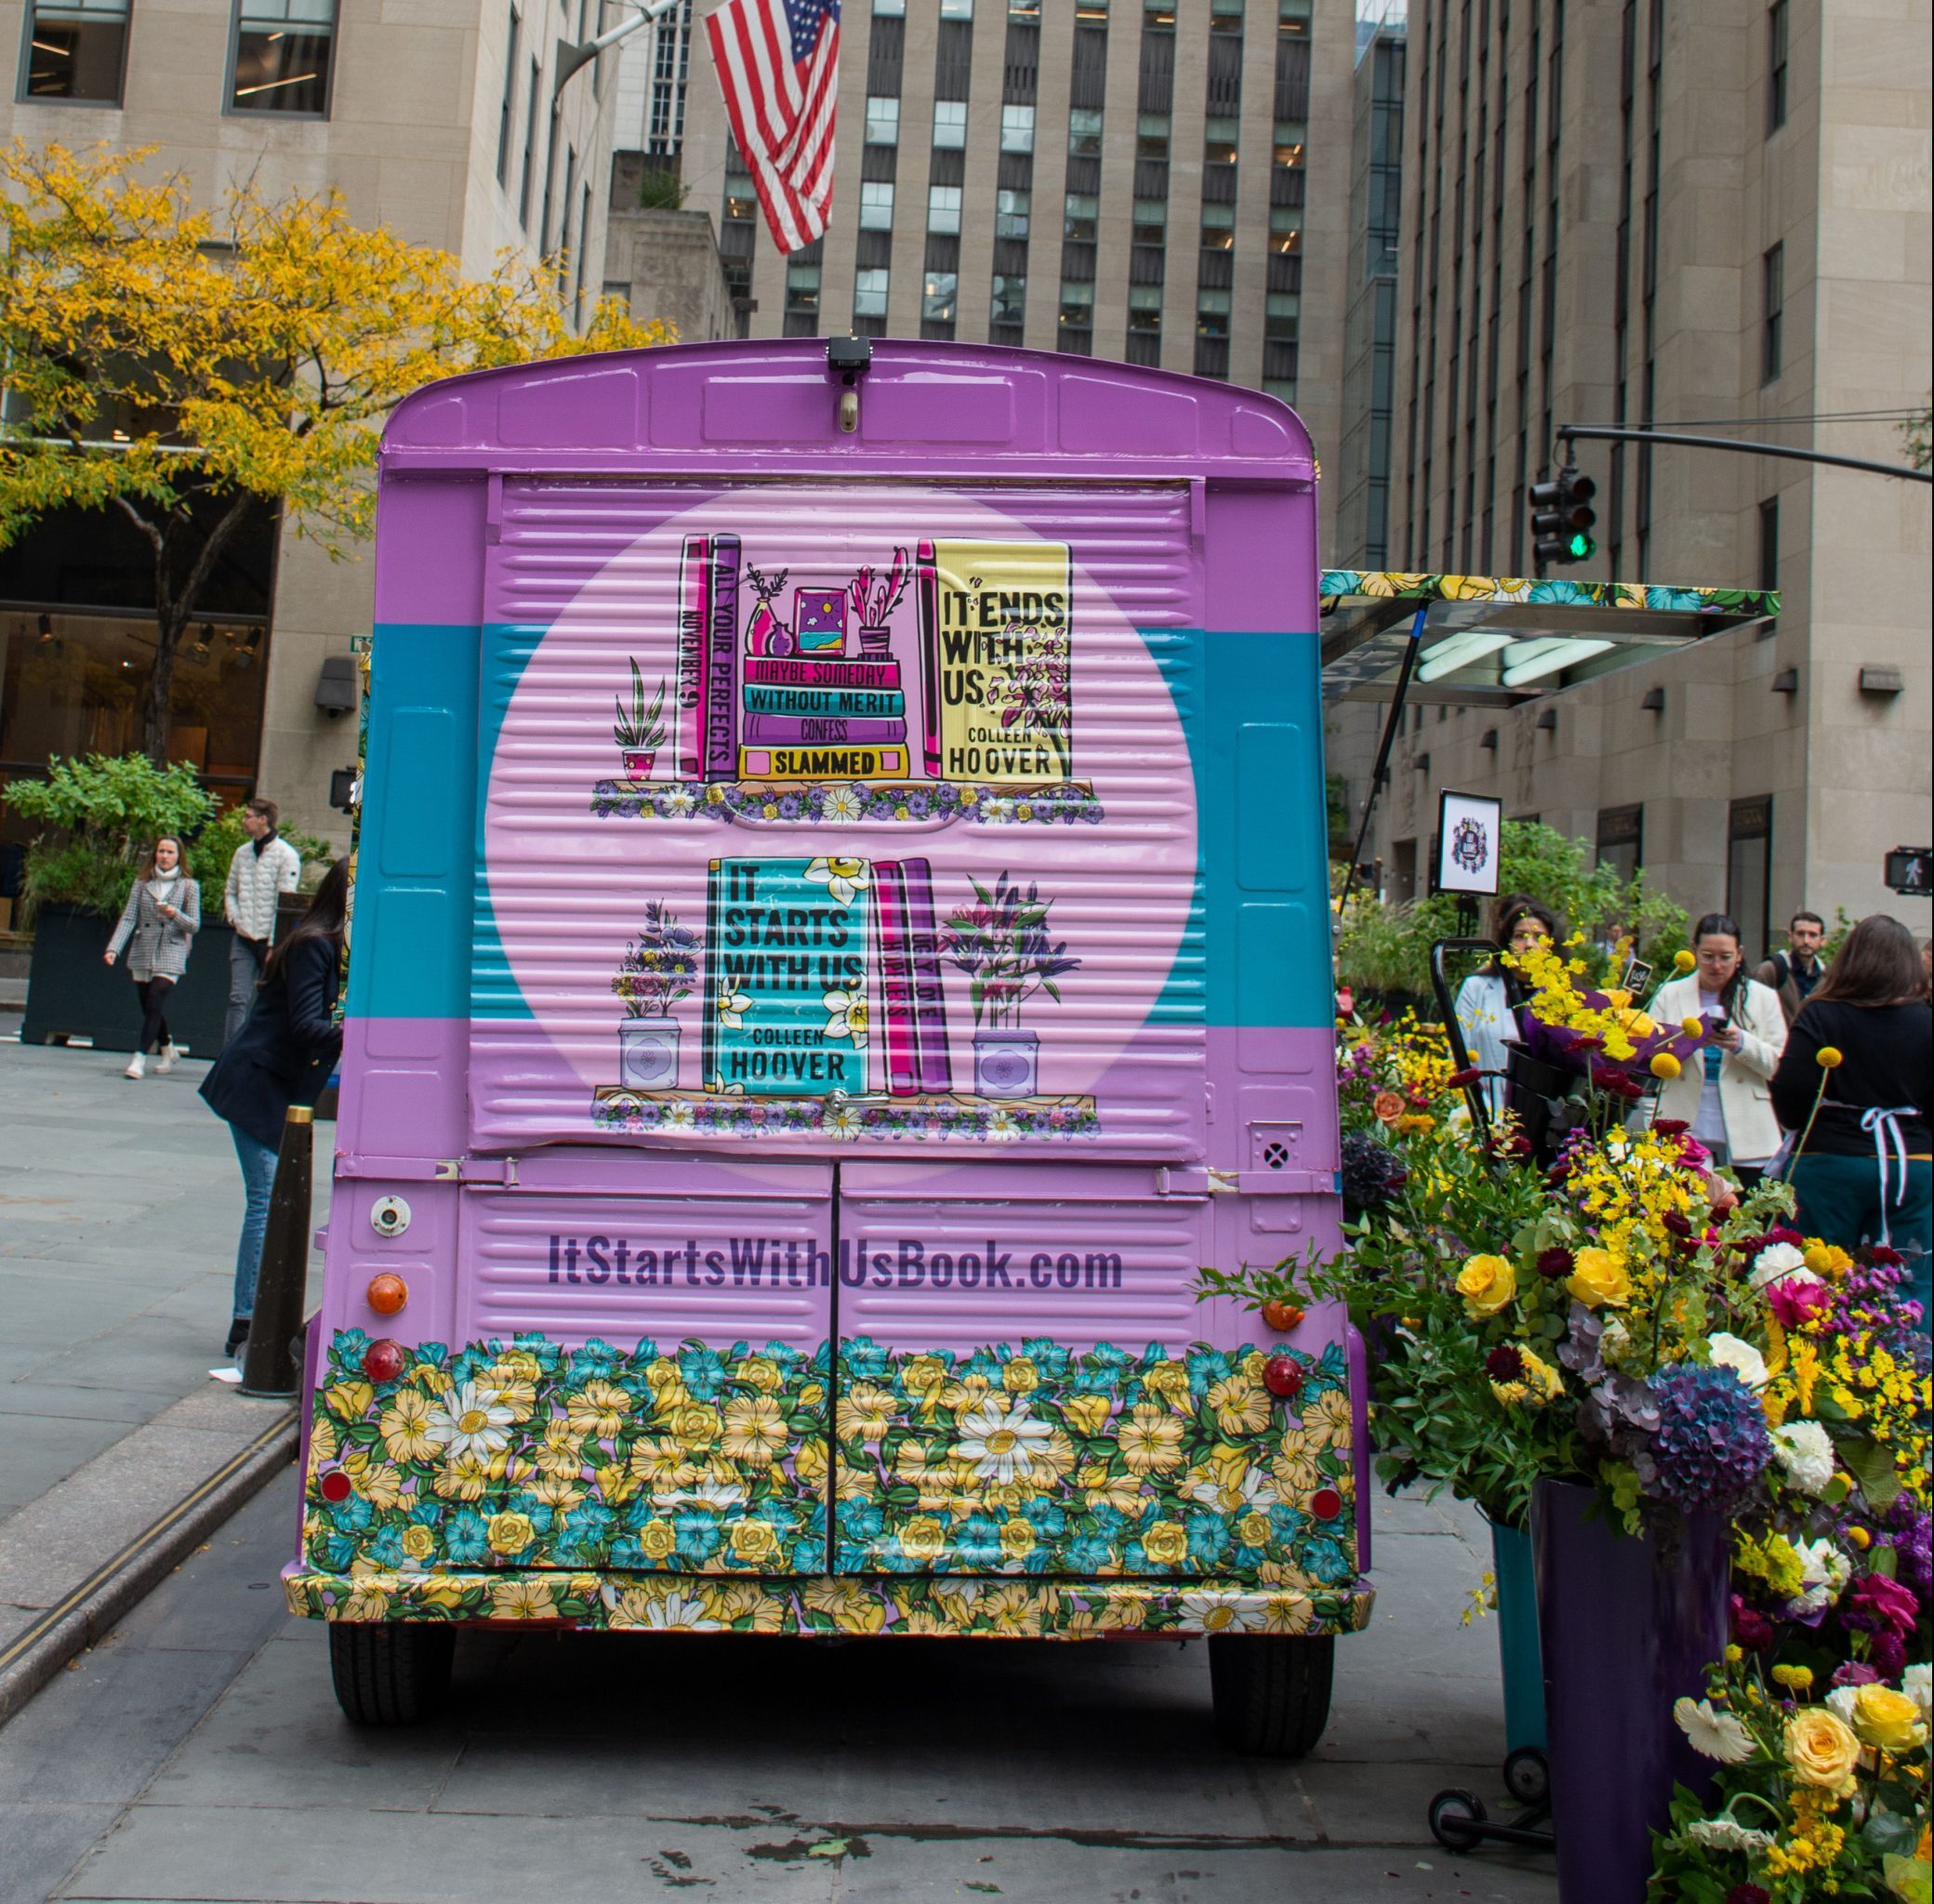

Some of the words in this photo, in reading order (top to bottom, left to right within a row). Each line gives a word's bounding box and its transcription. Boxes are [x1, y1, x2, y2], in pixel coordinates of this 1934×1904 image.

[714, 563, 735, 599] ALL
[712, 602, 735, 653] YOUR
[944, 591, 969, 626] IT
[979, 591, 1066, 628] ENDS
[680, 610, 704, 686] NOVEMBER
[942, 630, 1024, 666] WITH
[755, 660, 808, 682] MAYBE
[813, 662, 885, 685] SOMEDAY
[944, 669, 985, 706] US
[679, 691, 700, 708] 9
[708, 663, 732, 762] PERFECTS
[750, 690, 832, 711] WITHOUT
[839, 692, 896, 713] MERIT
[801, 719, 848, 742] CONFESS
[968, 727, 1032, 743] COLLEEN
[775, 751, 875, 775] SLAMMED
[949, 747, 1051, 774] HOOVER
[730, 866, 760, 902] IT
[724, 908, 849, 946] STARTS
[912, 933, 934, 972] UGLY
[723, 953, 810, 990] WITH
[819, 954, 863, 991] US
[915, 981, 938, 1019] LOVE
[752, 1028, 824, 1046] COLLEEN
[731, 1050, 845, 1080] HOOVER
[548, 1235, 1122, 1289] ItStartsWithUsBook.com
